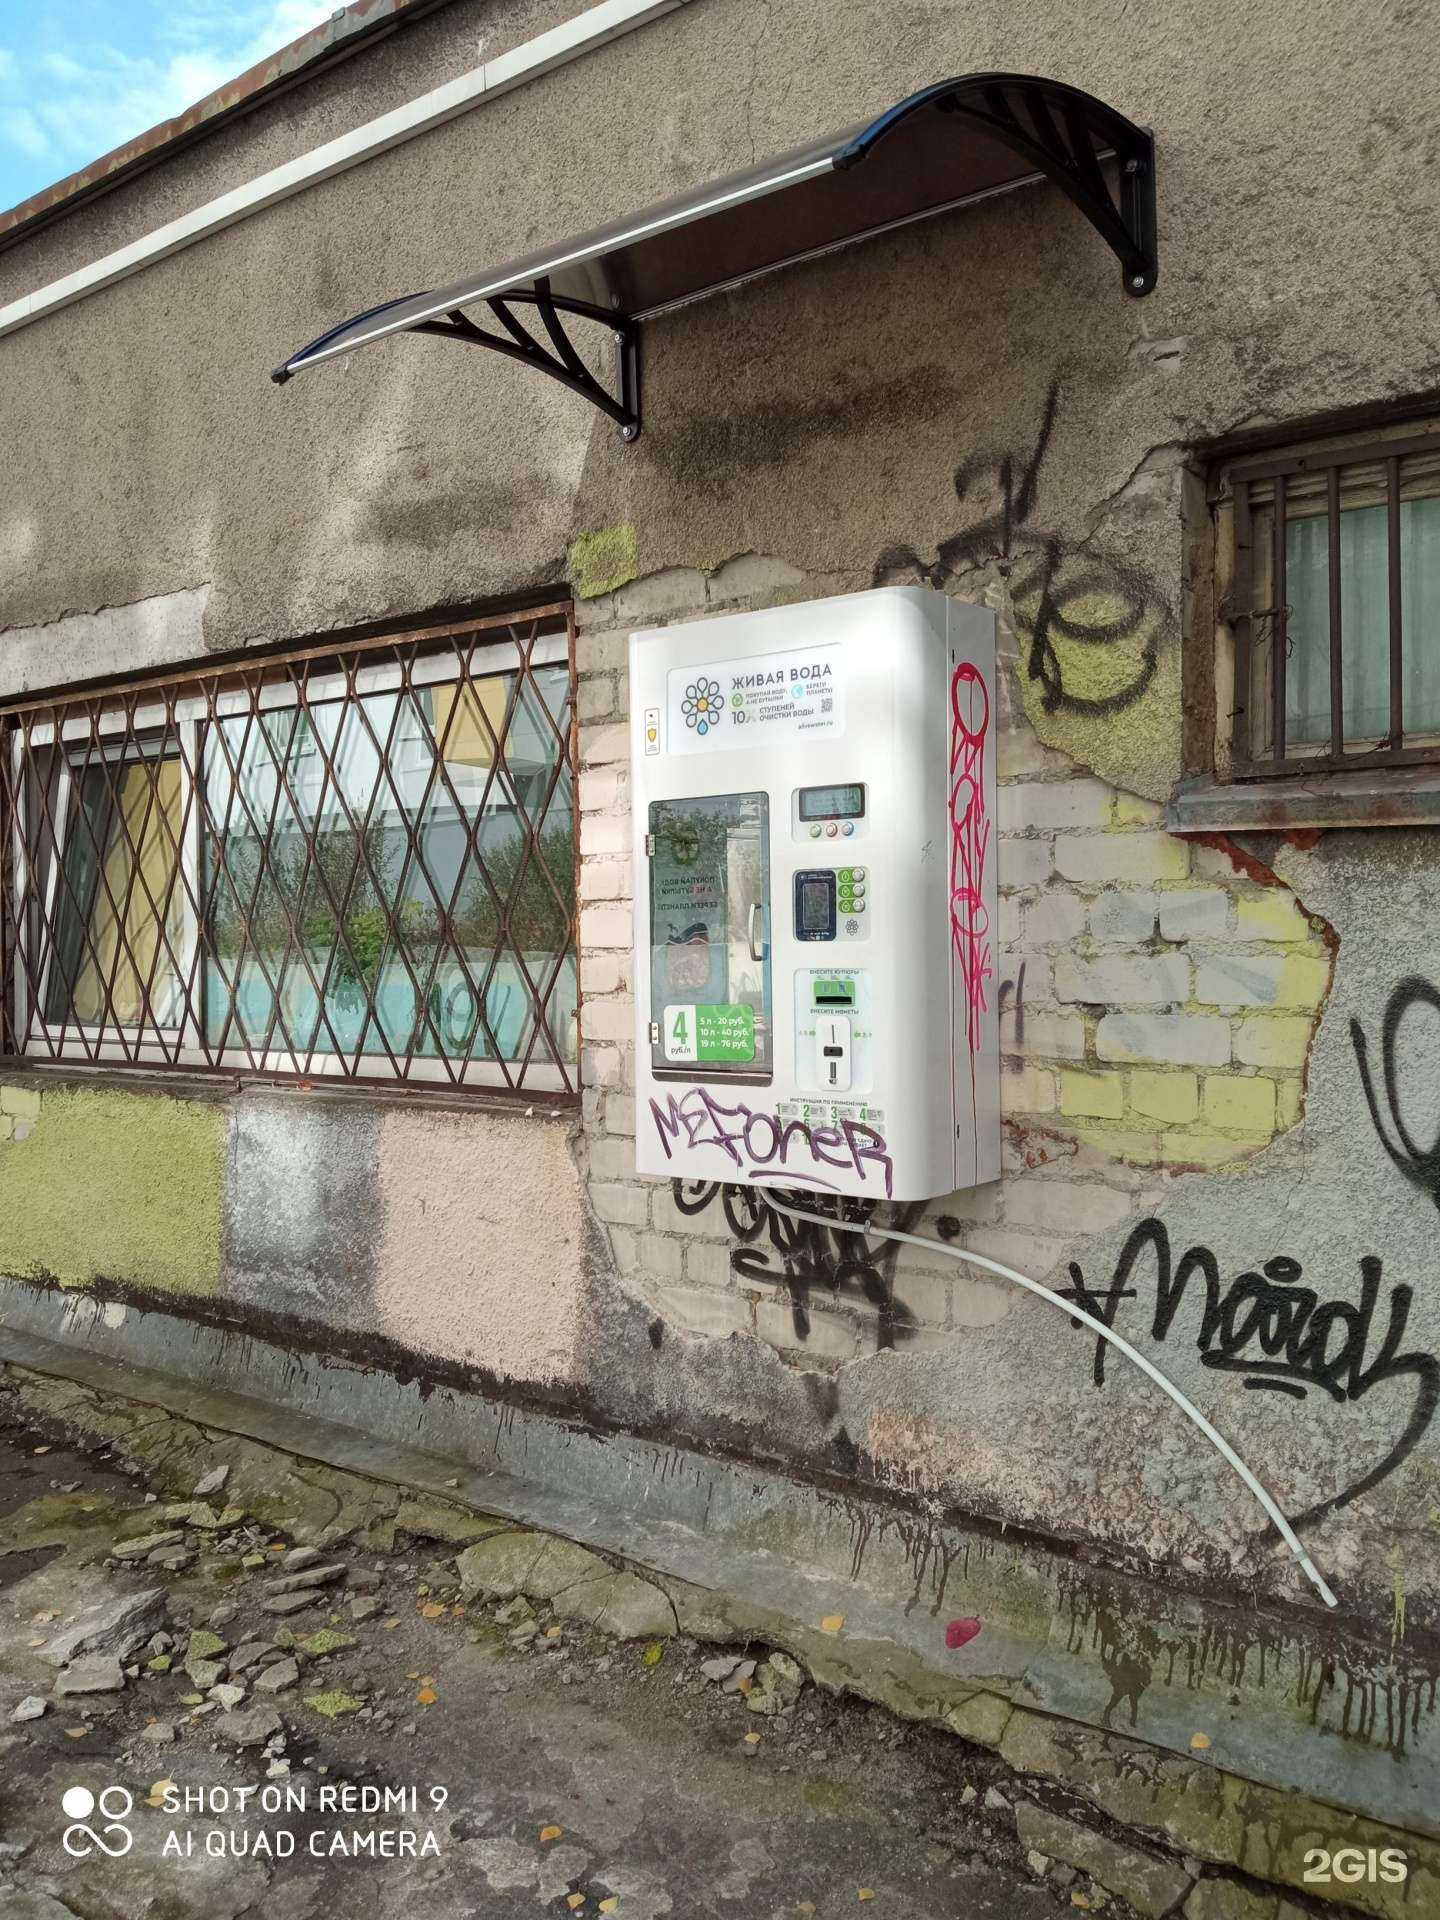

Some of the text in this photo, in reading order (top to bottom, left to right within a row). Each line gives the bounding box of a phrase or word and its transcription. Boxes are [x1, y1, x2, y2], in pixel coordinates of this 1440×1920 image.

[732, 664, 832, 690] ЖИВАЯ ВОДА
[759, 703, 795, 713] СТУПЕНЕЙ
[759, 709, 815, 721] ОЧИСТКИ ВОДЫ
[700, 1017, 705, 1025] 5
[718, 1017, 727, 1025] 20
[673, 1011, 688, 1045] 4
[700, 1028, 708, 1036] 10
[776, 1103, 781, 1115] 1
[803, 1104, 810, 1118] 2
[831, 1106, 838, 1119] 3
[859, 1108, 867, 1121] 4
